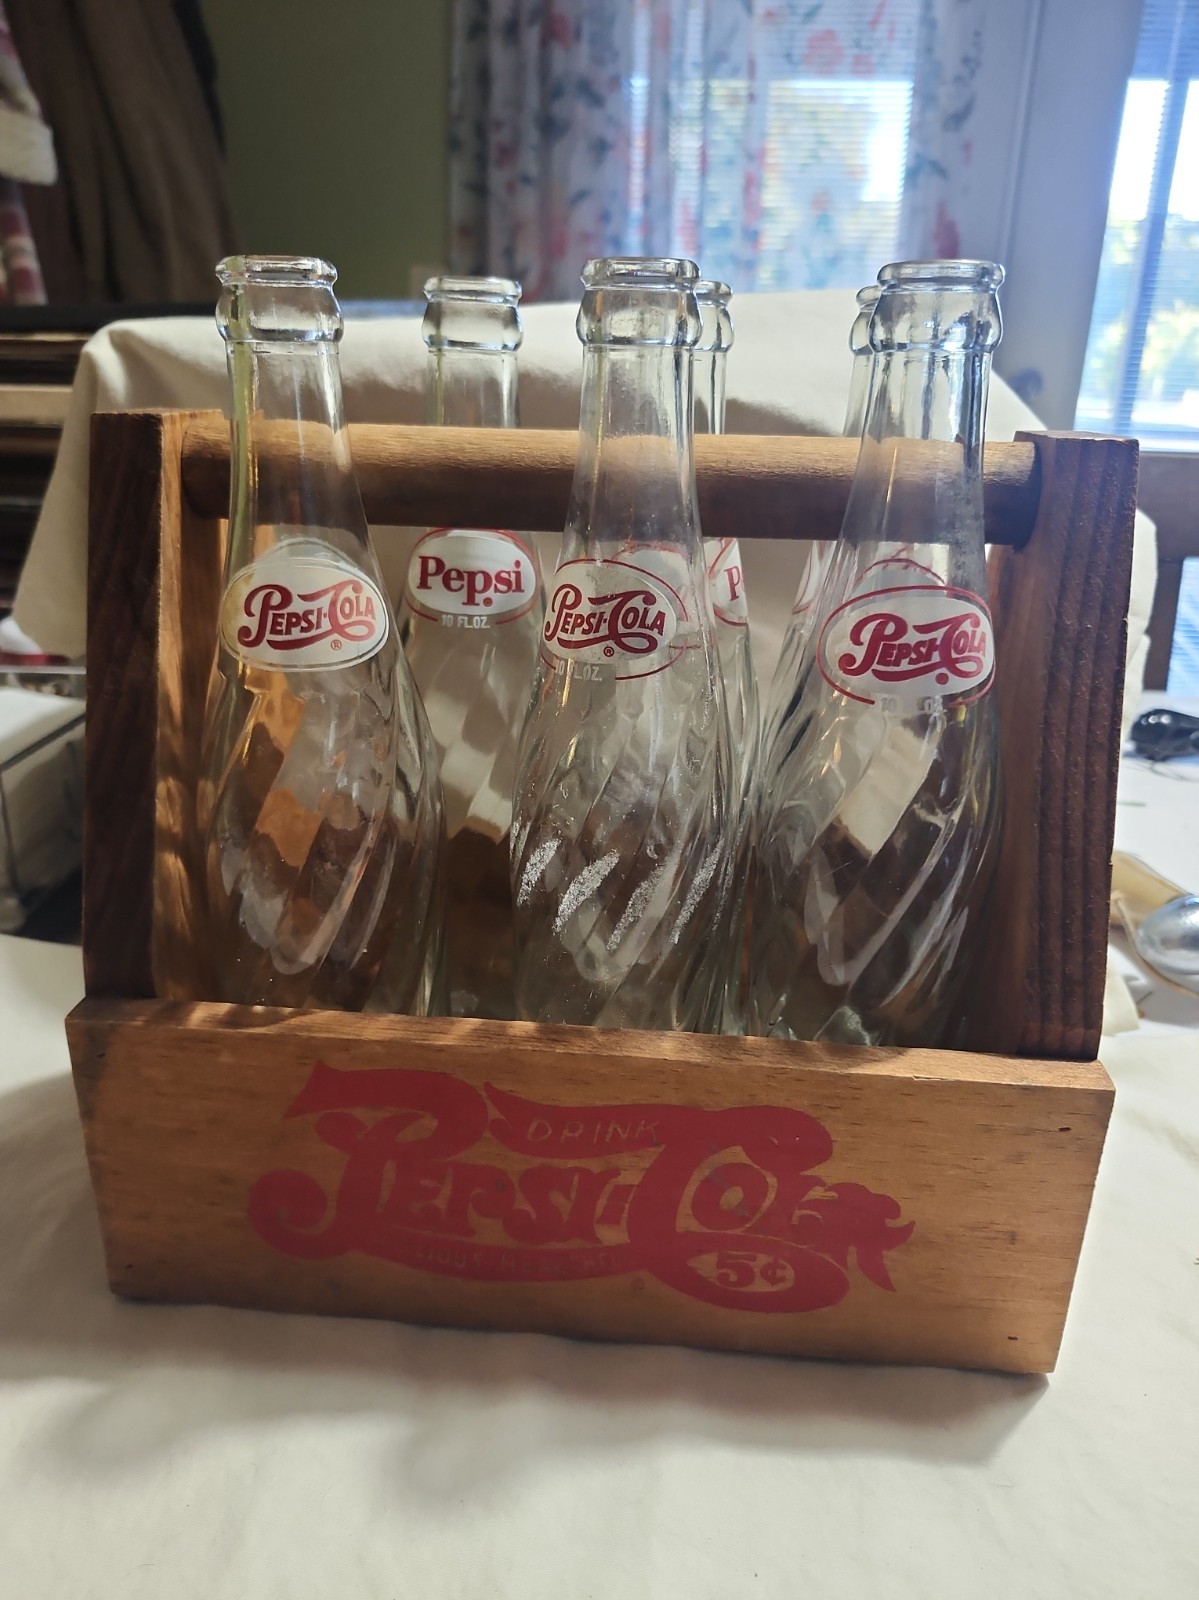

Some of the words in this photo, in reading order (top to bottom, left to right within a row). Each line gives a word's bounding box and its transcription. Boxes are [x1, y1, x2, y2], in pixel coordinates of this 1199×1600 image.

[416, 555, 525, 607] Pepsi
[441, 614, 454, 628] 10
[527, 1118, 660, 1144] DRINK
